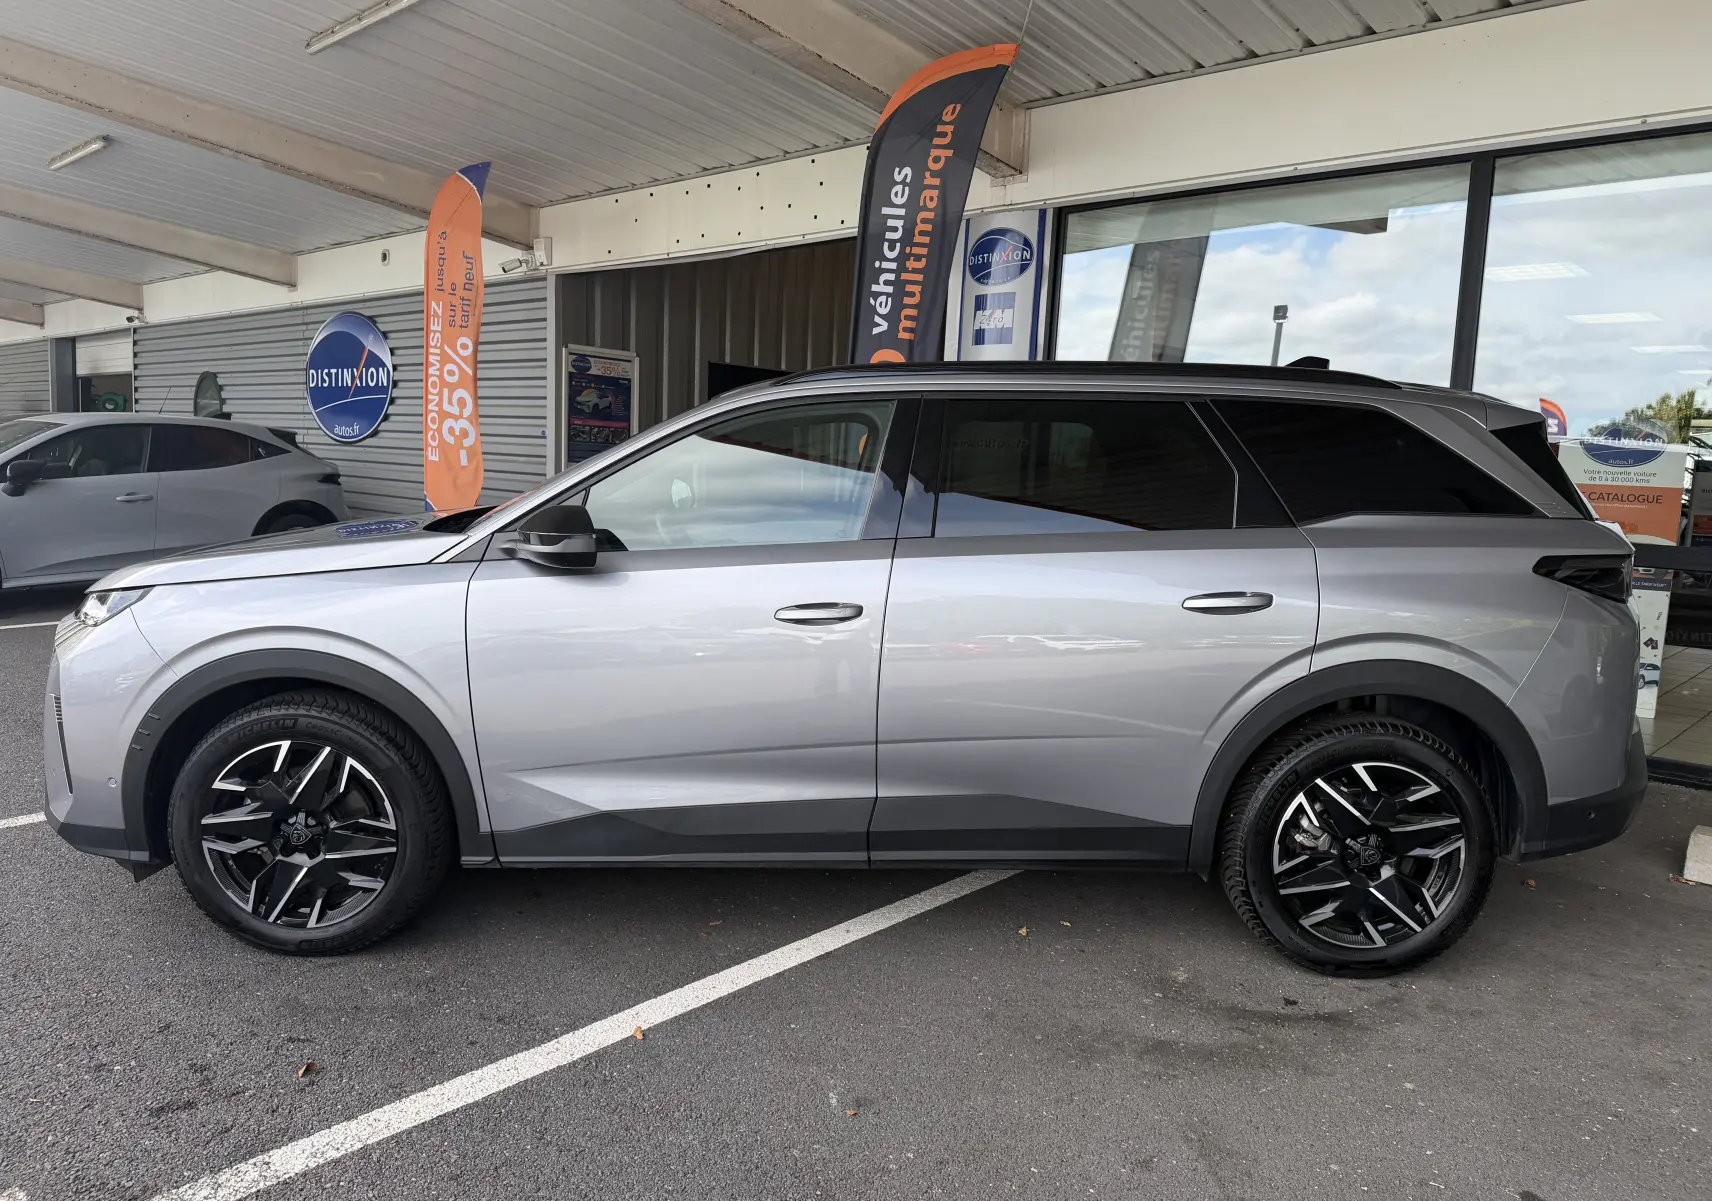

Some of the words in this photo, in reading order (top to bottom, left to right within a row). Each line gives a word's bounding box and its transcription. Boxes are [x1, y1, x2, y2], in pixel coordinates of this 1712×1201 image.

[897, 102, 962, 341] multimarque
[434, 230, 448, 293] jusqu'à
[869, 165, 913, 336] véhicules
[968, 249, 1032, 267] DISTINXION
[463, 250, 475, 292] neuf
[448, 281, 457, 297] le
[448, 301, 457, 328] sur
[459, 295, 473, 330] tarif
[308, 366, 388, 388] DISTINXION
[426, 300, 443, 462] ÉCONOMISEZ
[442, 336, 476, 466] -35%
[333, 422, 360, 437] autos.fr
[1583, 435, 1664, 448] DISTINXION
[1583, 468, 1602, 476] Votre
[1602, 469, 1632, 477] nouvelle
[1633, 470, 1658, 478] voiture
[1608, 458, 1635, 466] autos.fr
[1620, 476, 1634, 484] 000
[1635, 476, 1650, 484] kms
[1588, 491, 1664, 504] CATALOGUE
